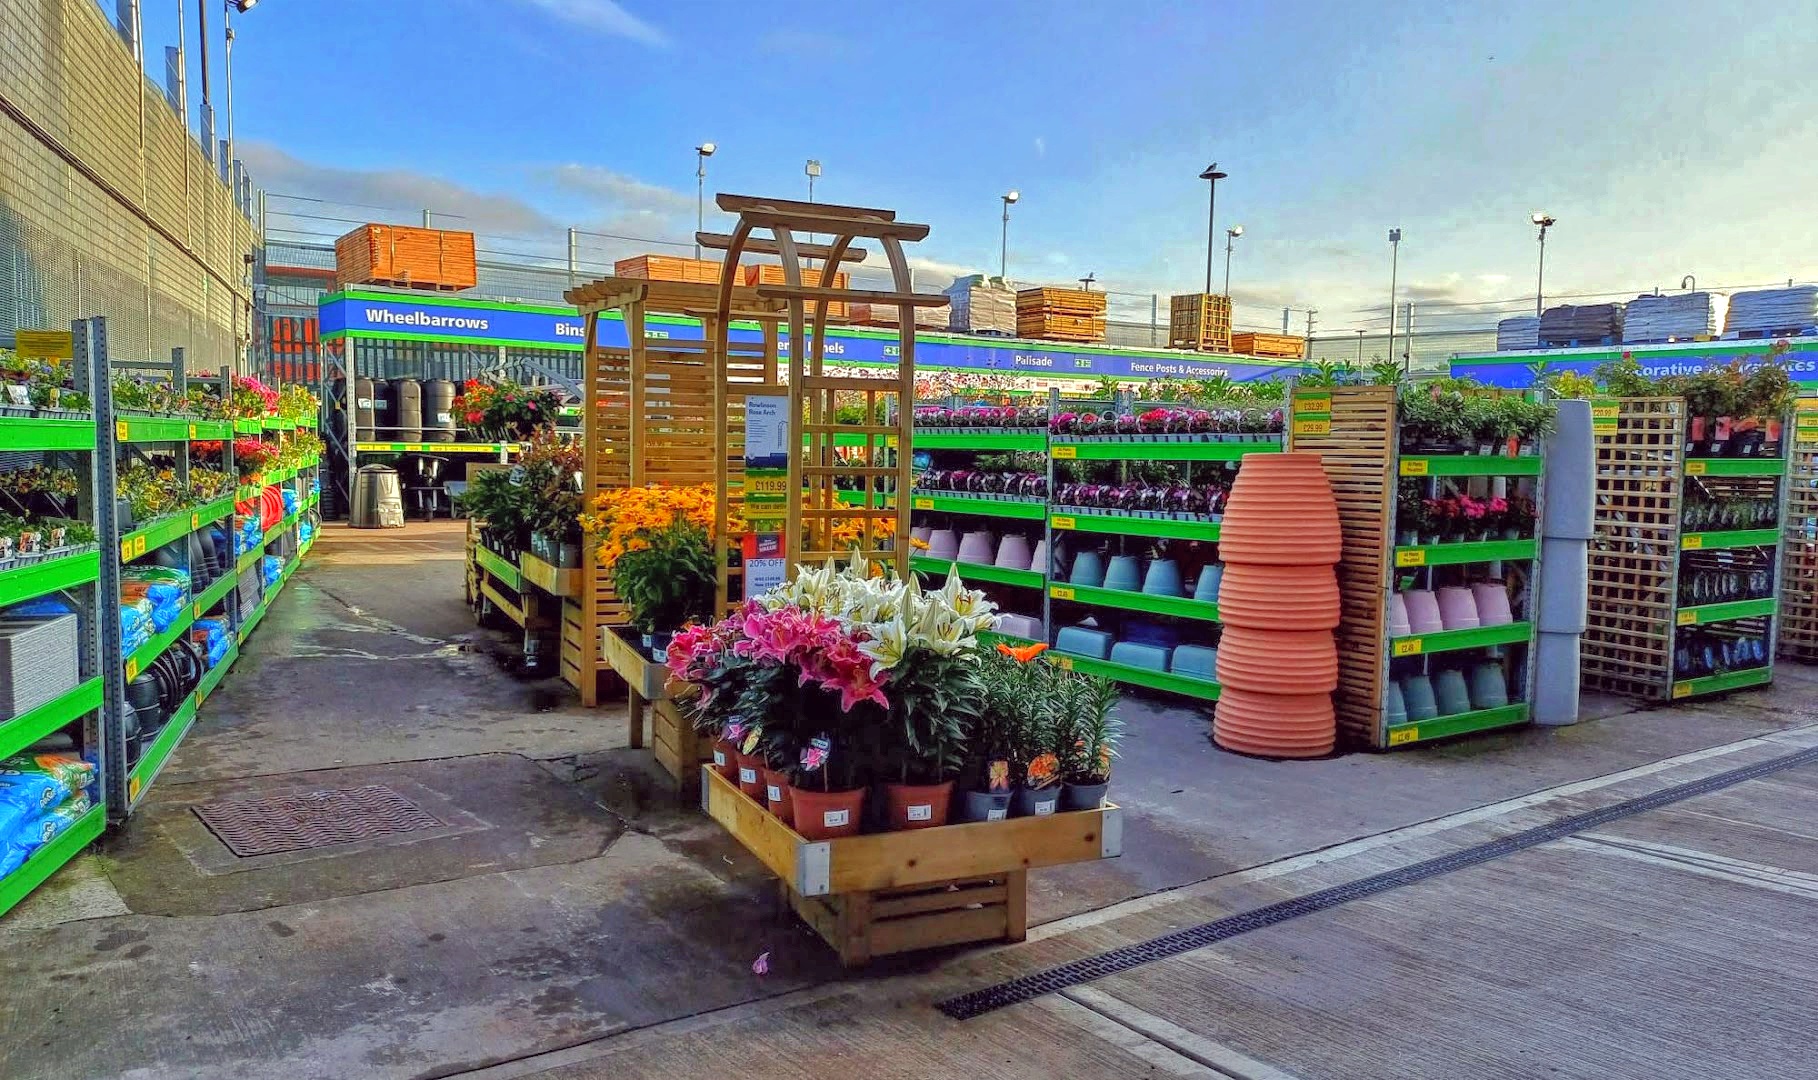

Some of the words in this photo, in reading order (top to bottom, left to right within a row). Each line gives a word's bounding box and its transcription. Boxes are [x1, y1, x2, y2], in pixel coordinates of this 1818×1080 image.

[366, 308, 489, 330] Wheelbarrows
[1015, 355, 1053, 367] Palisade
[1130, 362, 1155, 373] Fence
[1156, 365, 1177, 374] Posts
[1178, 365, 1185, 375] &
[1186, 366, 1229, 377] Accessories
[755, 481, 787, 491] £119.99
[749, 560, 766, 568] 20%
